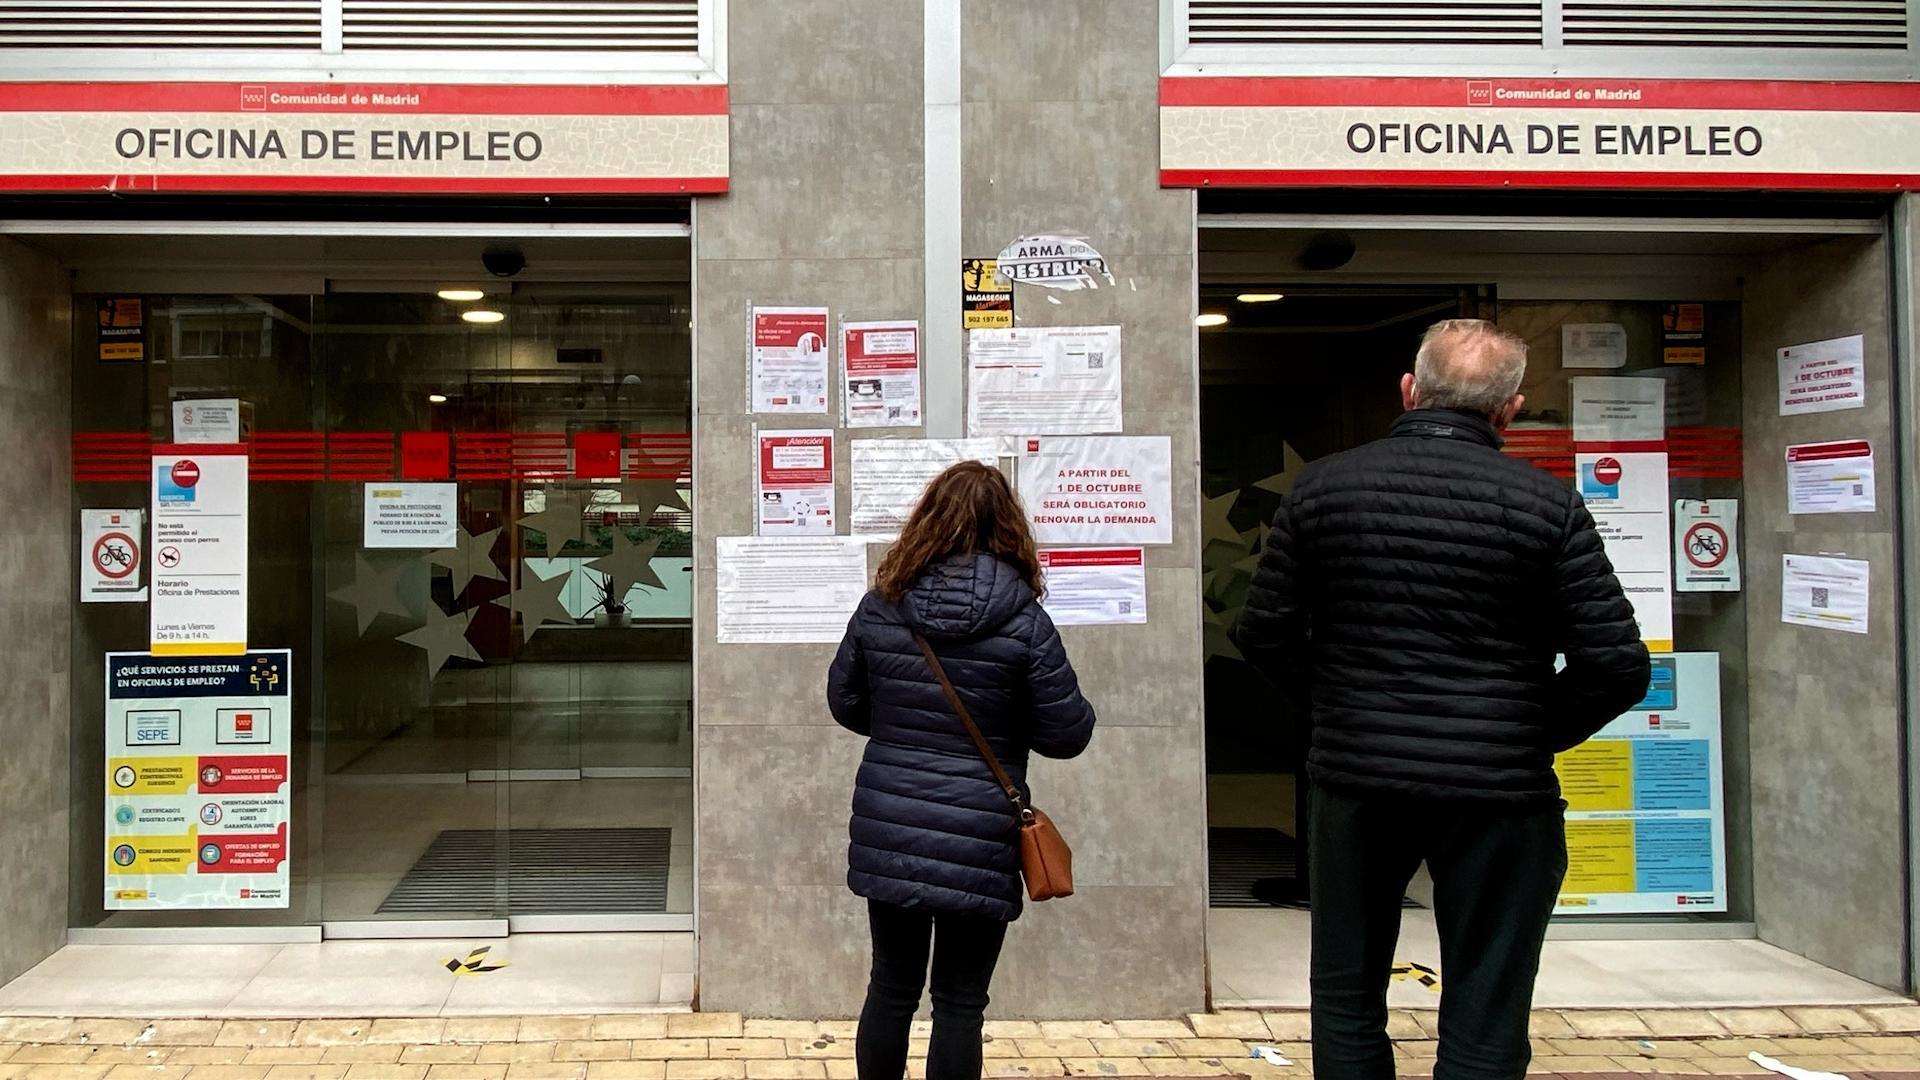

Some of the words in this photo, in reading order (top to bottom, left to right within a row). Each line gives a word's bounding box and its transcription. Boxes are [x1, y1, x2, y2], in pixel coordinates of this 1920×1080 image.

[1495, 88, 1572, 100] Comunidad
[1574, 88, 1592, 100] de
[1594, 89, 1641, 100] Madrid
[270, 94, 348, 105] Comunidad
[350, 94, 368, 105] de
[372, 94, 420, 106] Madrid
[1346, 122, 1513, 154] OFICINA
[1527, 124, 1580, 155] DE
[1594, 125, 1762, 156] EMPLEO
[115, 128, 287, 159] OFICINA
[301, 129, 356, 160] DE
[370, 130, 542, 162] EMPLEO
[1018, 244, 1065, 258] ARMA
[1814, 367, 1855, 378] OCTUBRE
[786, 437, 824, 446] ¡Atención!
[1058, 470, 1066, 478] A
[1068, 470, 1107, 478] PARTIR
[1110, 470, 1130, 478] DEL
[1057, 484, 1062, 492] 1
[1067, 484, 1082, 492] DE
[1086, 484, 1142, 492] OCTUBRE
[1043, 500, 1070, 509] SERÁ
[1073, 501, 1146, 509] OBLIGATORIO
[1034, 516, 1084, 524] RENOVAR
[1088, 516, 1101, 524] LA
[1104, 516, 1156, 524] DEMANDA
[116, 665, 139, 677] ¿QUÉ
[140, 666, 186, 675] SERVICIOS
[200, 665, 240, 673] PRESTAN
[118, 679, 130, 687] EN
[130, 678, 172, 687] OFICINAS
[173, 678, 185, 686] DE
[186, 677, 226, 686] EMPLEO?
[137, 730, 168, 740] SEPE
